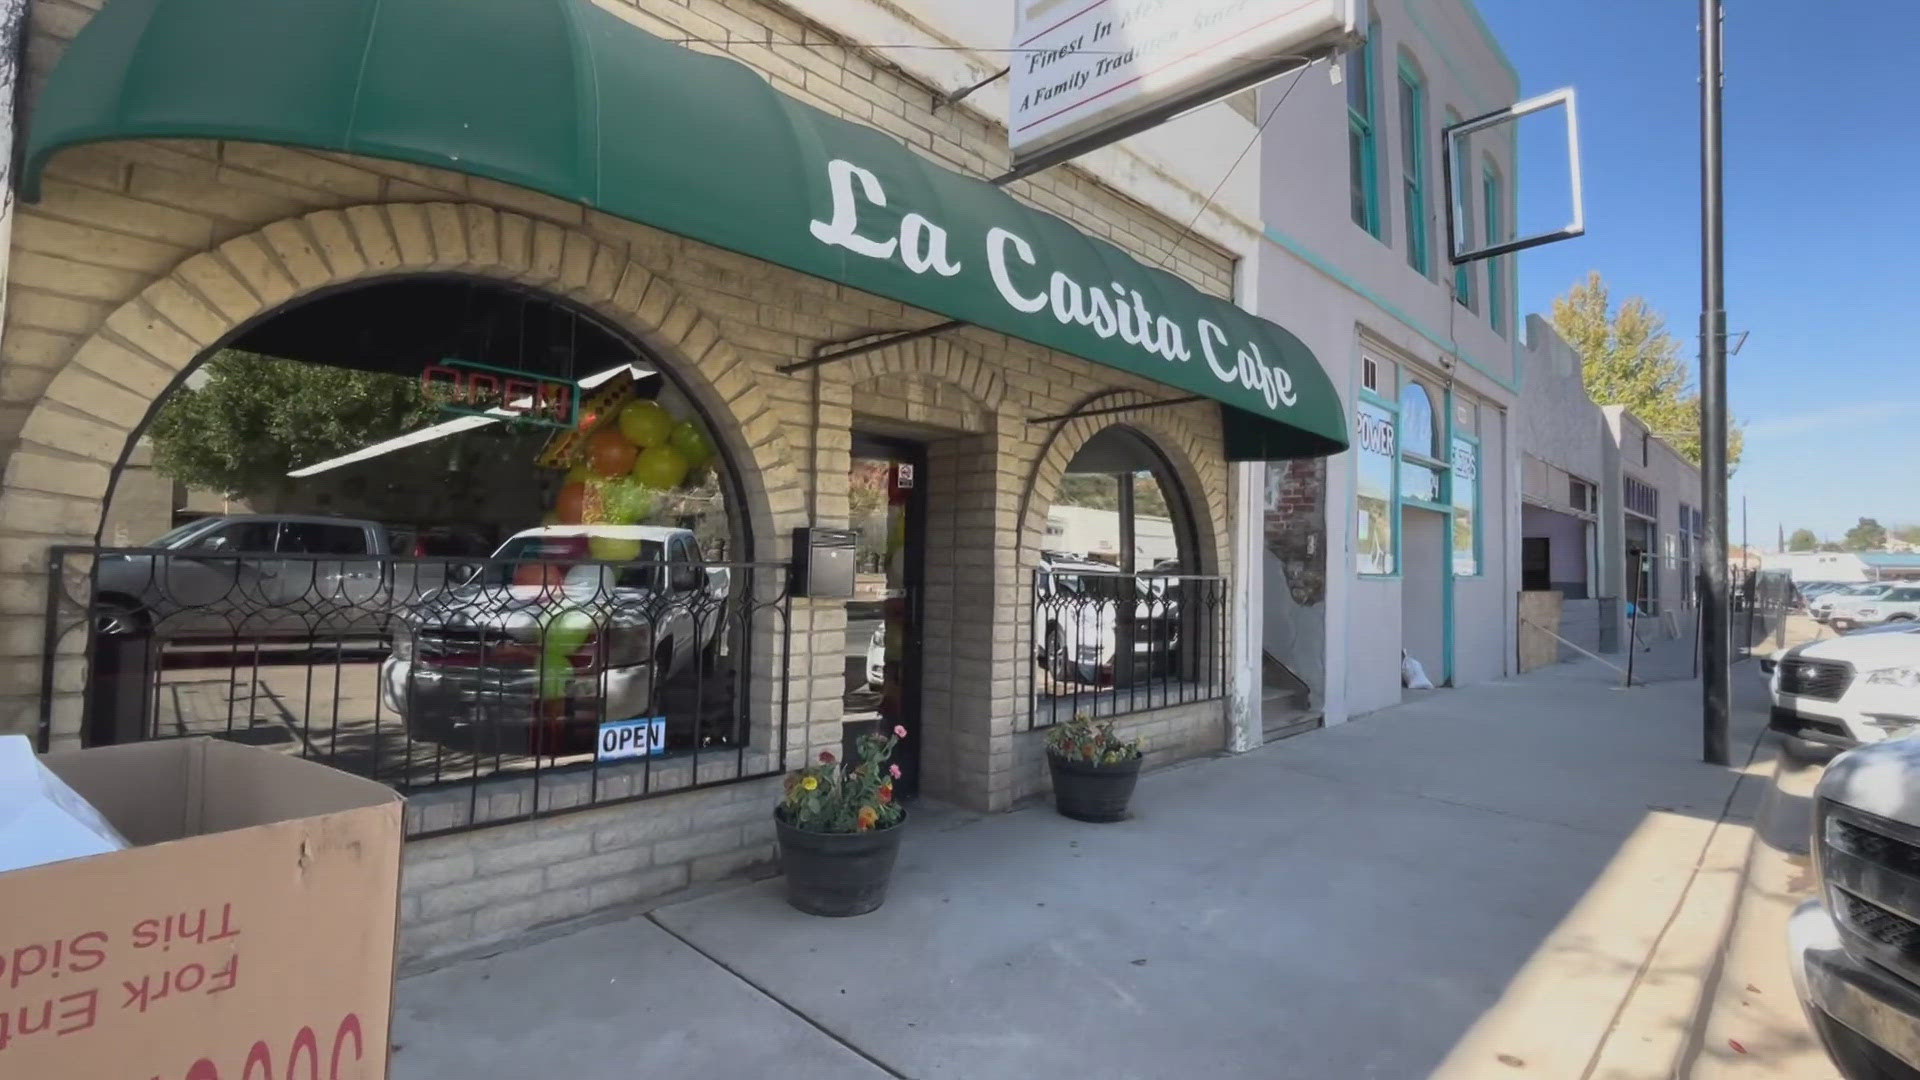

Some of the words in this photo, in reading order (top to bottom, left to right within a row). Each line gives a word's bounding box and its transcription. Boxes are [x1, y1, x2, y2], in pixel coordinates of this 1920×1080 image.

[1093, 21, 1112, 42] In
[1018, 94, 1030, 113] A
[1033, 70, 1090, 106] Family
[809, 158, 962, 277] La
[986, 226, 1191, 363] Casita
[1197, 318, 1298, 410] Cafe
[421, 365, 571, 422] OPEN
[1357, 411, 1395, 457] POWER
[602, 724, 660, 752] OPEN
[132, 903, 242, 952] This
[0, 930, 109, 989] Sid
[121, 953, 239, 1013] Fork
